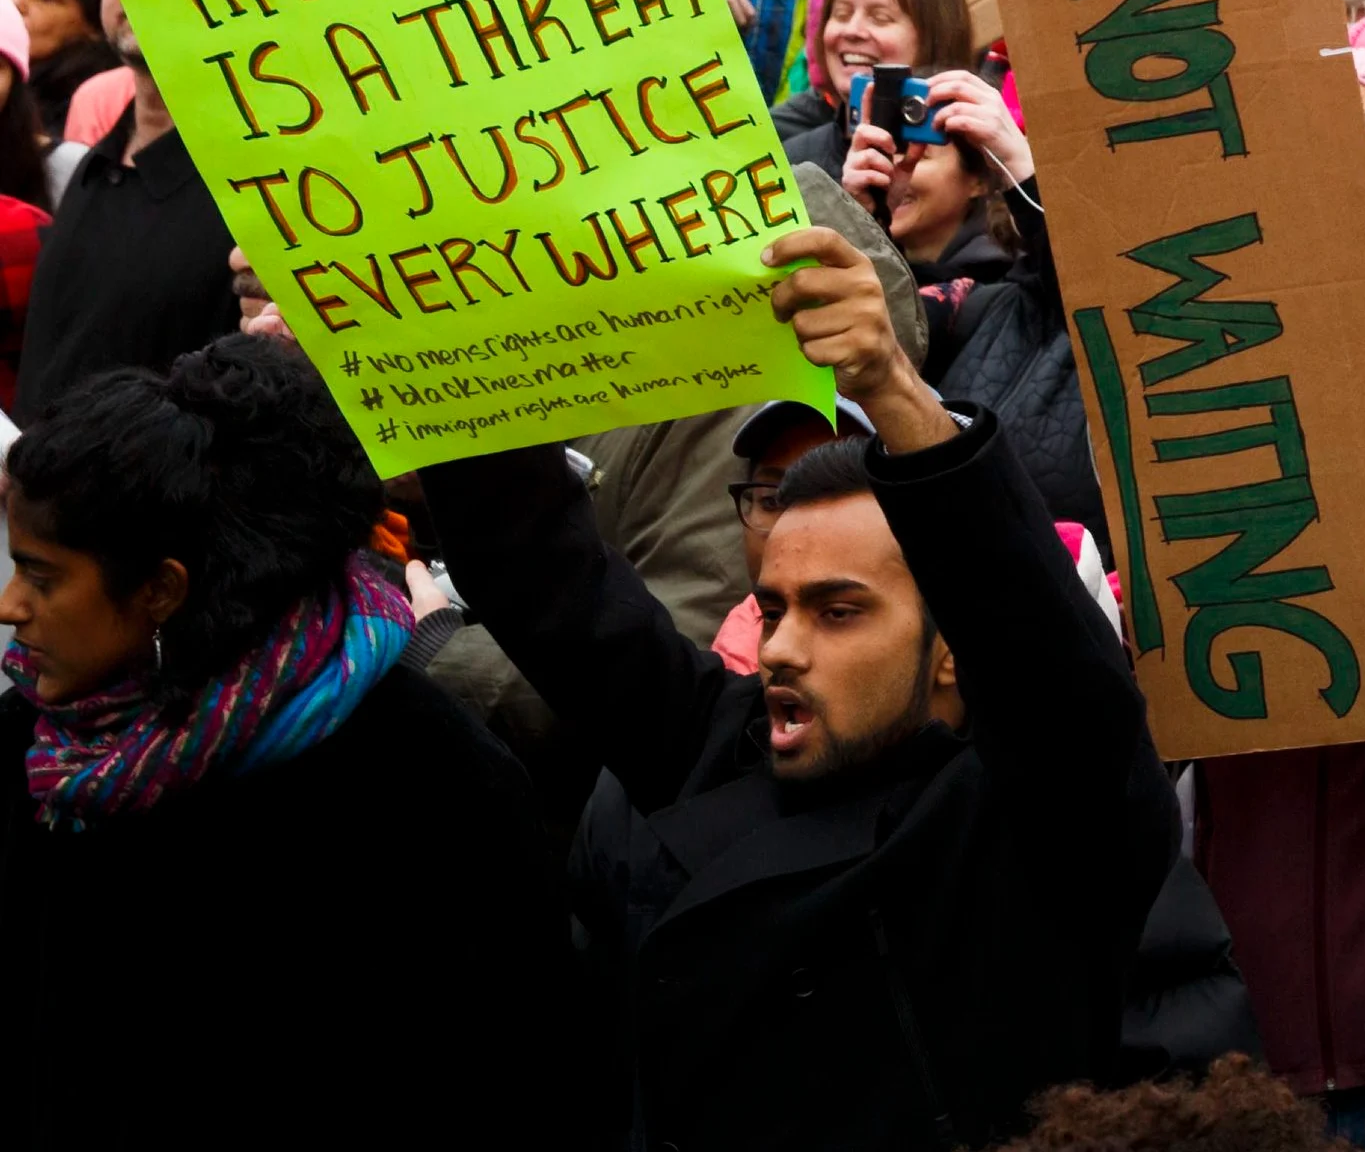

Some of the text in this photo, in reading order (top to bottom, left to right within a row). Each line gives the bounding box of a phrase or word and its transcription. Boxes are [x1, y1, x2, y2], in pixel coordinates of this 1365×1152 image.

[203, 40, 323, 141] IS
[324, 22, 401, 115] A
[227, 52, 763, 250] TO JUSTICE
[1116, 210, 1363, 721] WAITING
